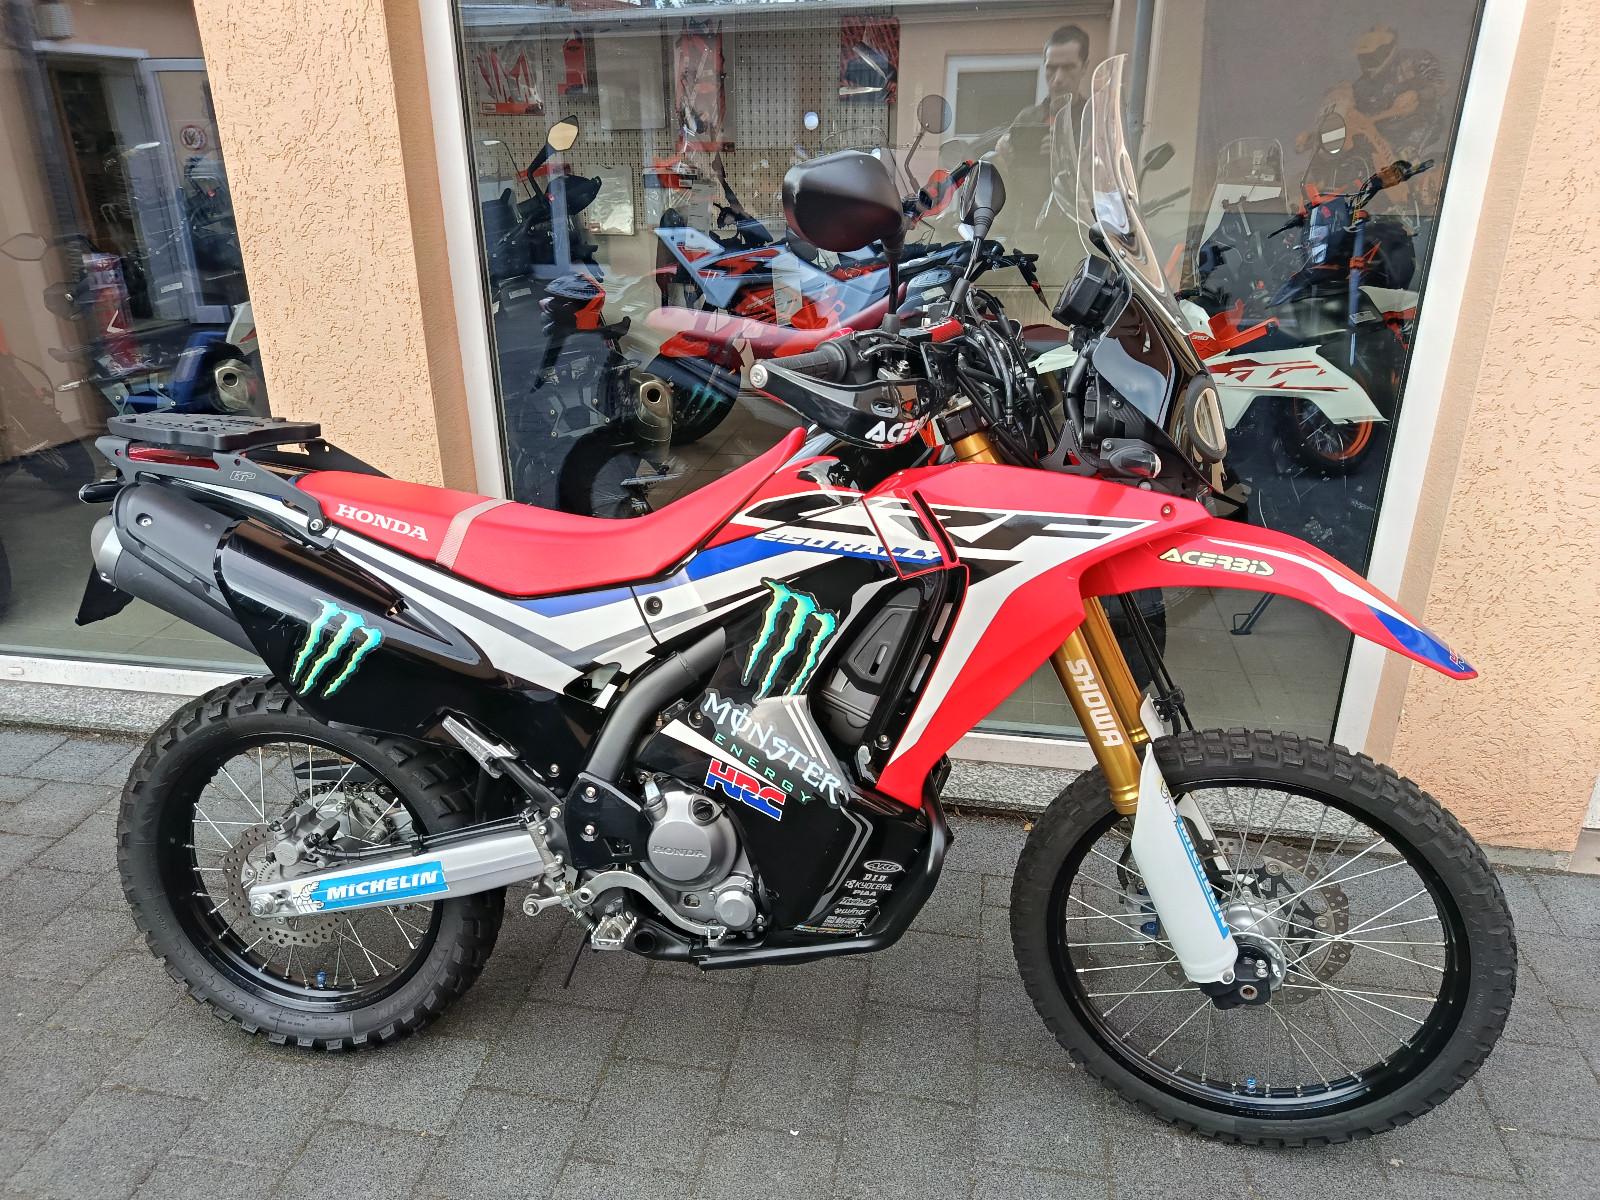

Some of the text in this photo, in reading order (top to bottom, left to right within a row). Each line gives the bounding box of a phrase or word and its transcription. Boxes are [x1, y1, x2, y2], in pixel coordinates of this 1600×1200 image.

[336, 503, 428, 542] HONDA
[1065, 658, 1124, 747] SHOWA
[704, 757, 787, 822] HRC
[714, 732, 812, 806] ENERGY
